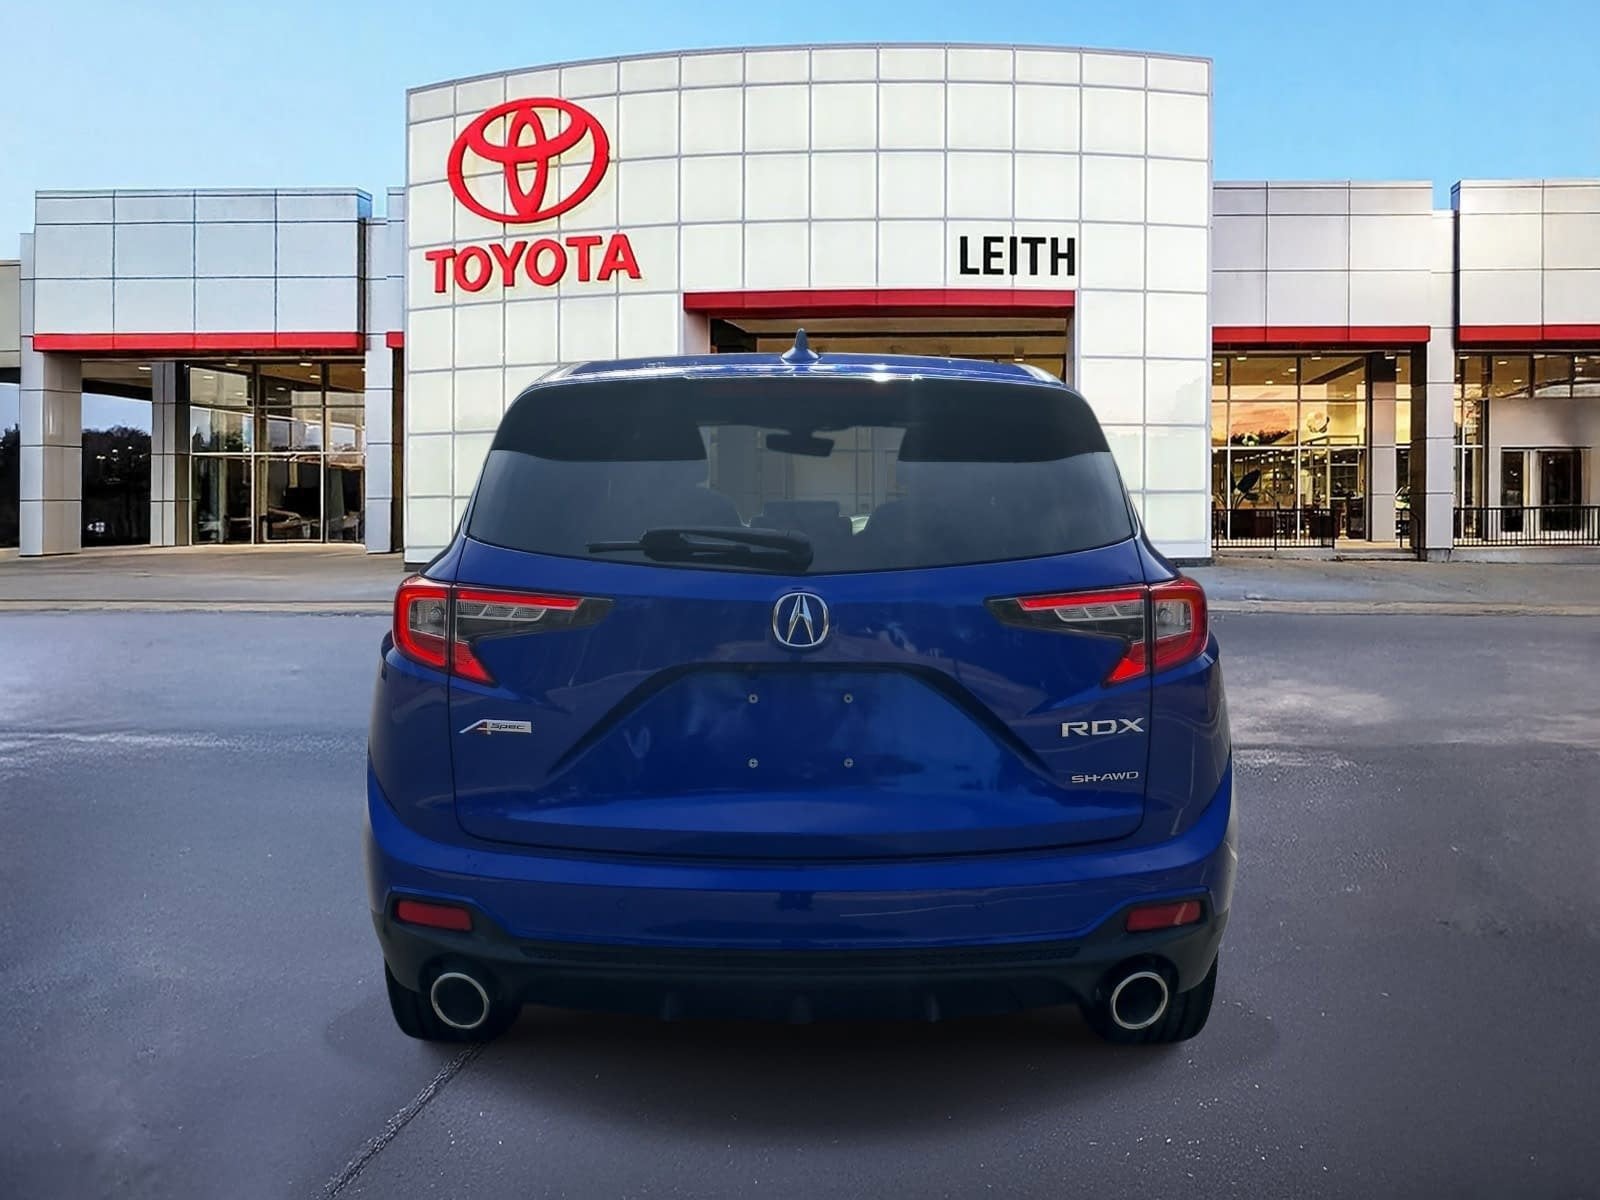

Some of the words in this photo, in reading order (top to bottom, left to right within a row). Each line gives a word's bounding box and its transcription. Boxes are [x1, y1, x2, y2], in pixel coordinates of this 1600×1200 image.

[425, 233, 641, 293] TOYOTA
[960, 236, 1075, 276] LEITH
[1061, 717, 1144, 737] RDX
[1071, 771, 1139, 783] SH-AWD
